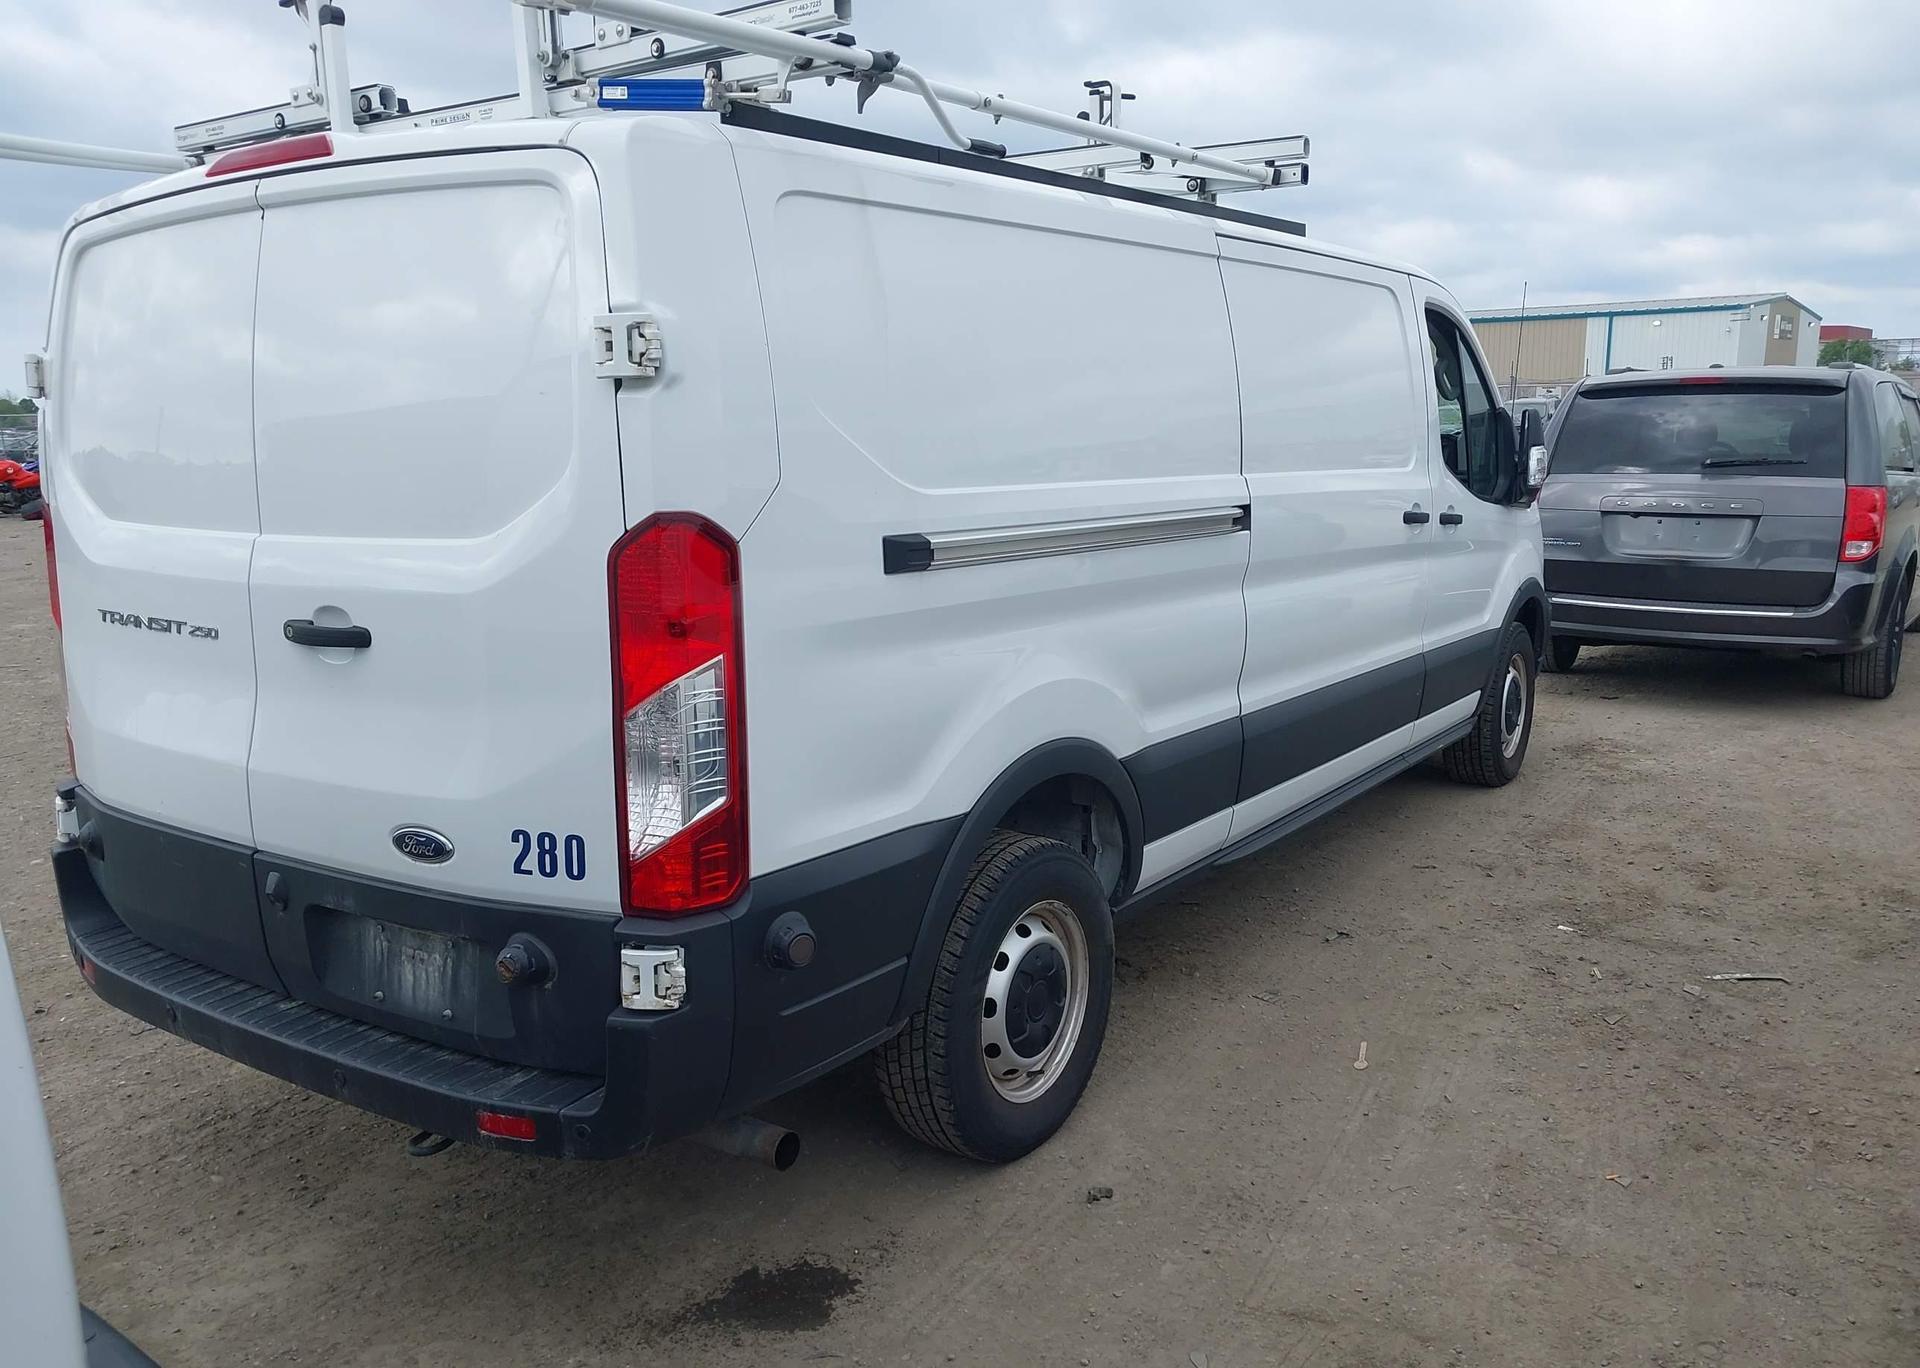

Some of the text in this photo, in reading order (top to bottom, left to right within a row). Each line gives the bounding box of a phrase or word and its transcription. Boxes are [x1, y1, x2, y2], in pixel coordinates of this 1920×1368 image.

[449, 111, 471, 122] DESIGN
[97, 608, 219, 640] TRANSIT 250
[402, 833, 436, 857] Ford
[511, 828, 587, 881] 280
